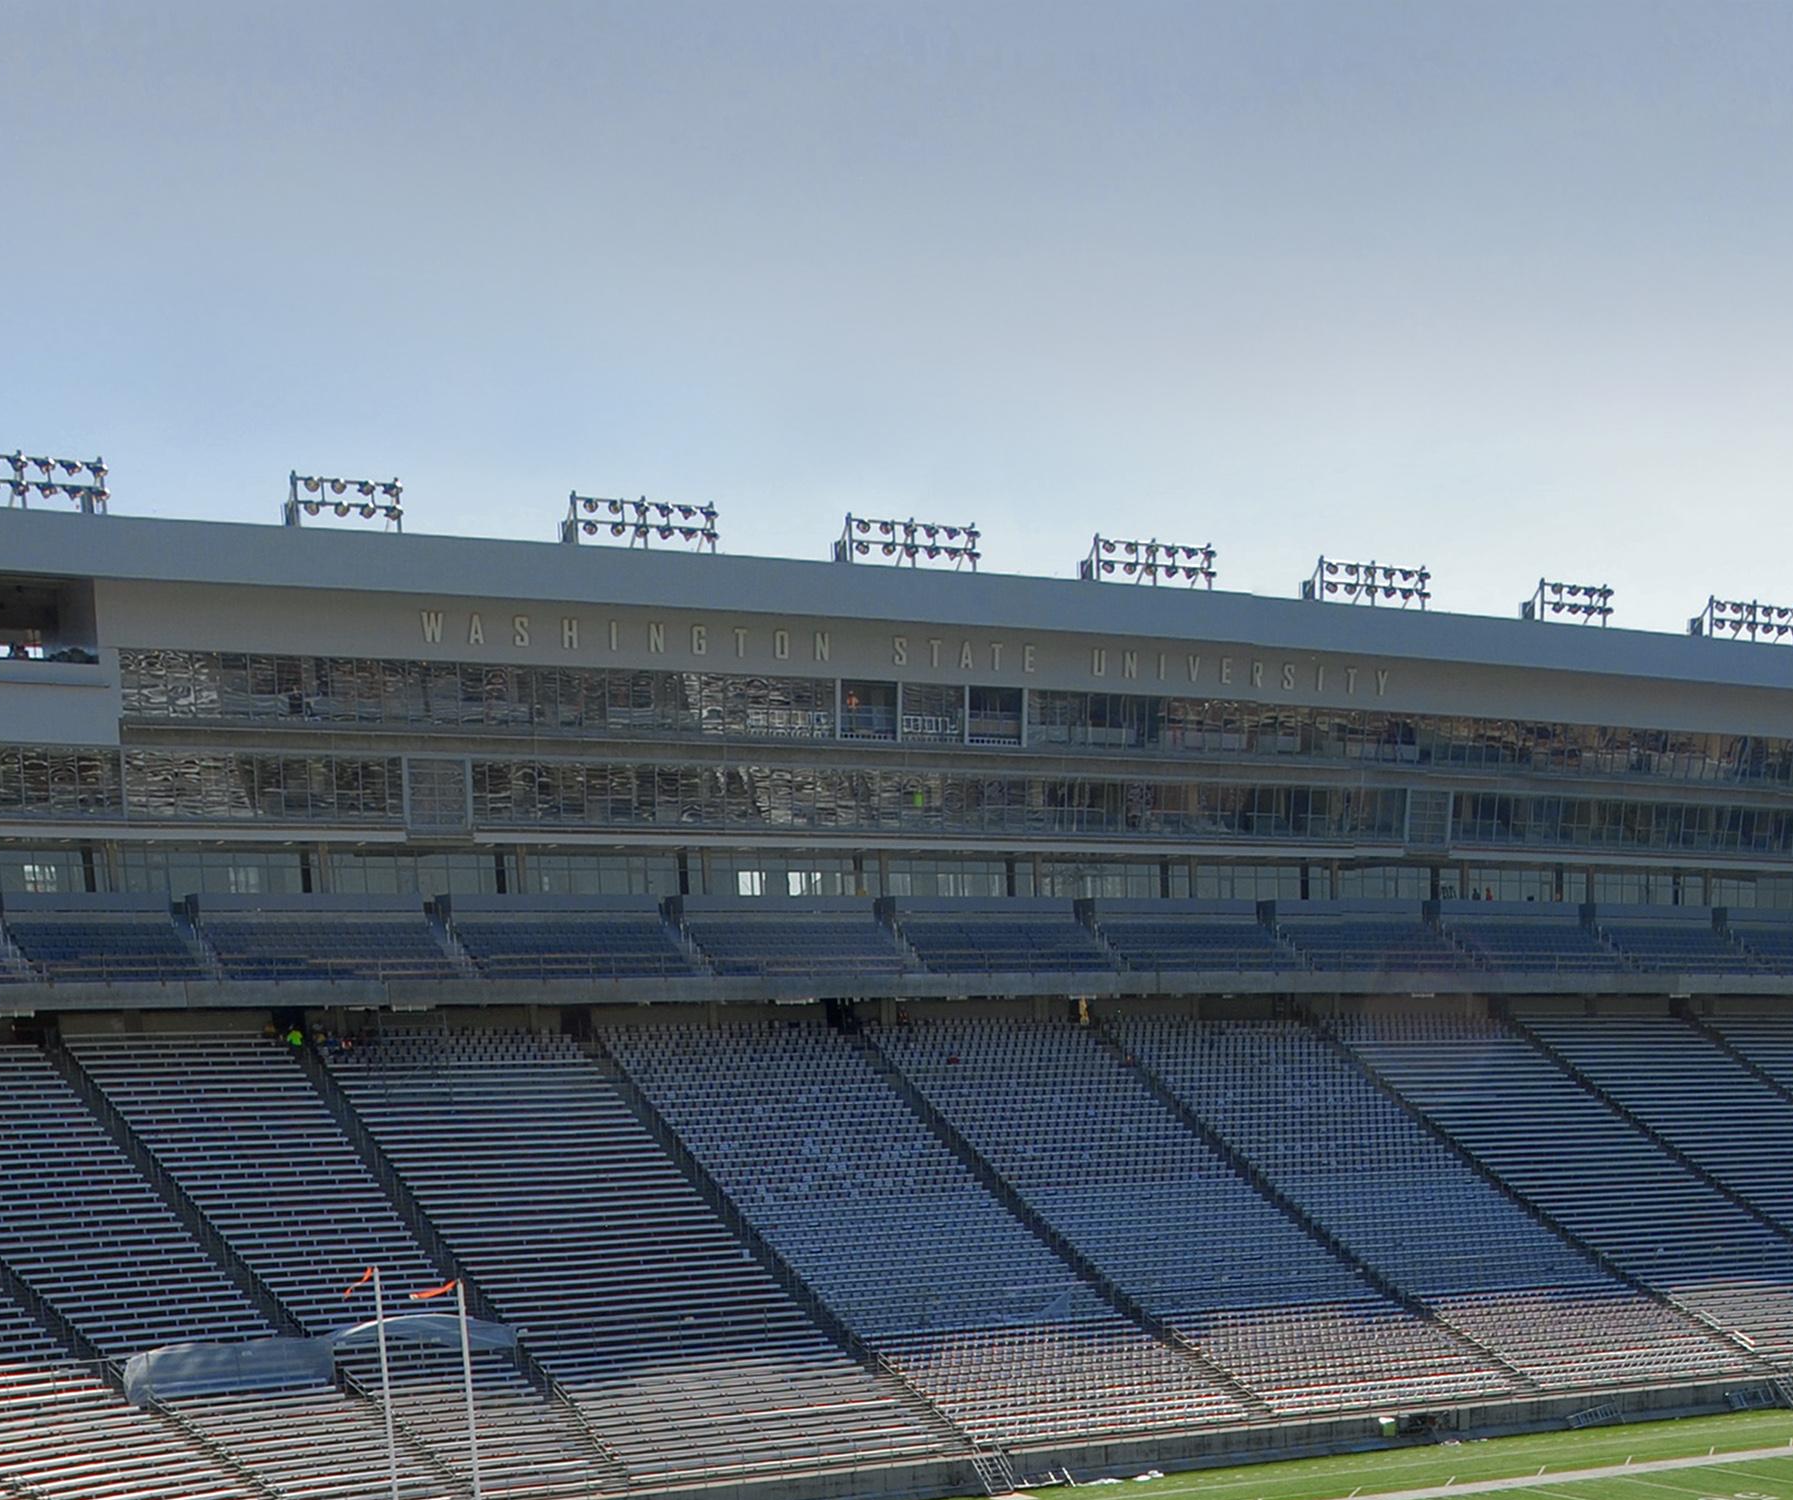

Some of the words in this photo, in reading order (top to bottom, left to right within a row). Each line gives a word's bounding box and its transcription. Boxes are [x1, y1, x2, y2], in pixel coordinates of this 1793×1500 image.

[421, 611, 830, 661] WASHINGTON
[892, 637, 1035, 673] STATE
[1092, 648, 1390, 695] UNIVERSITY
